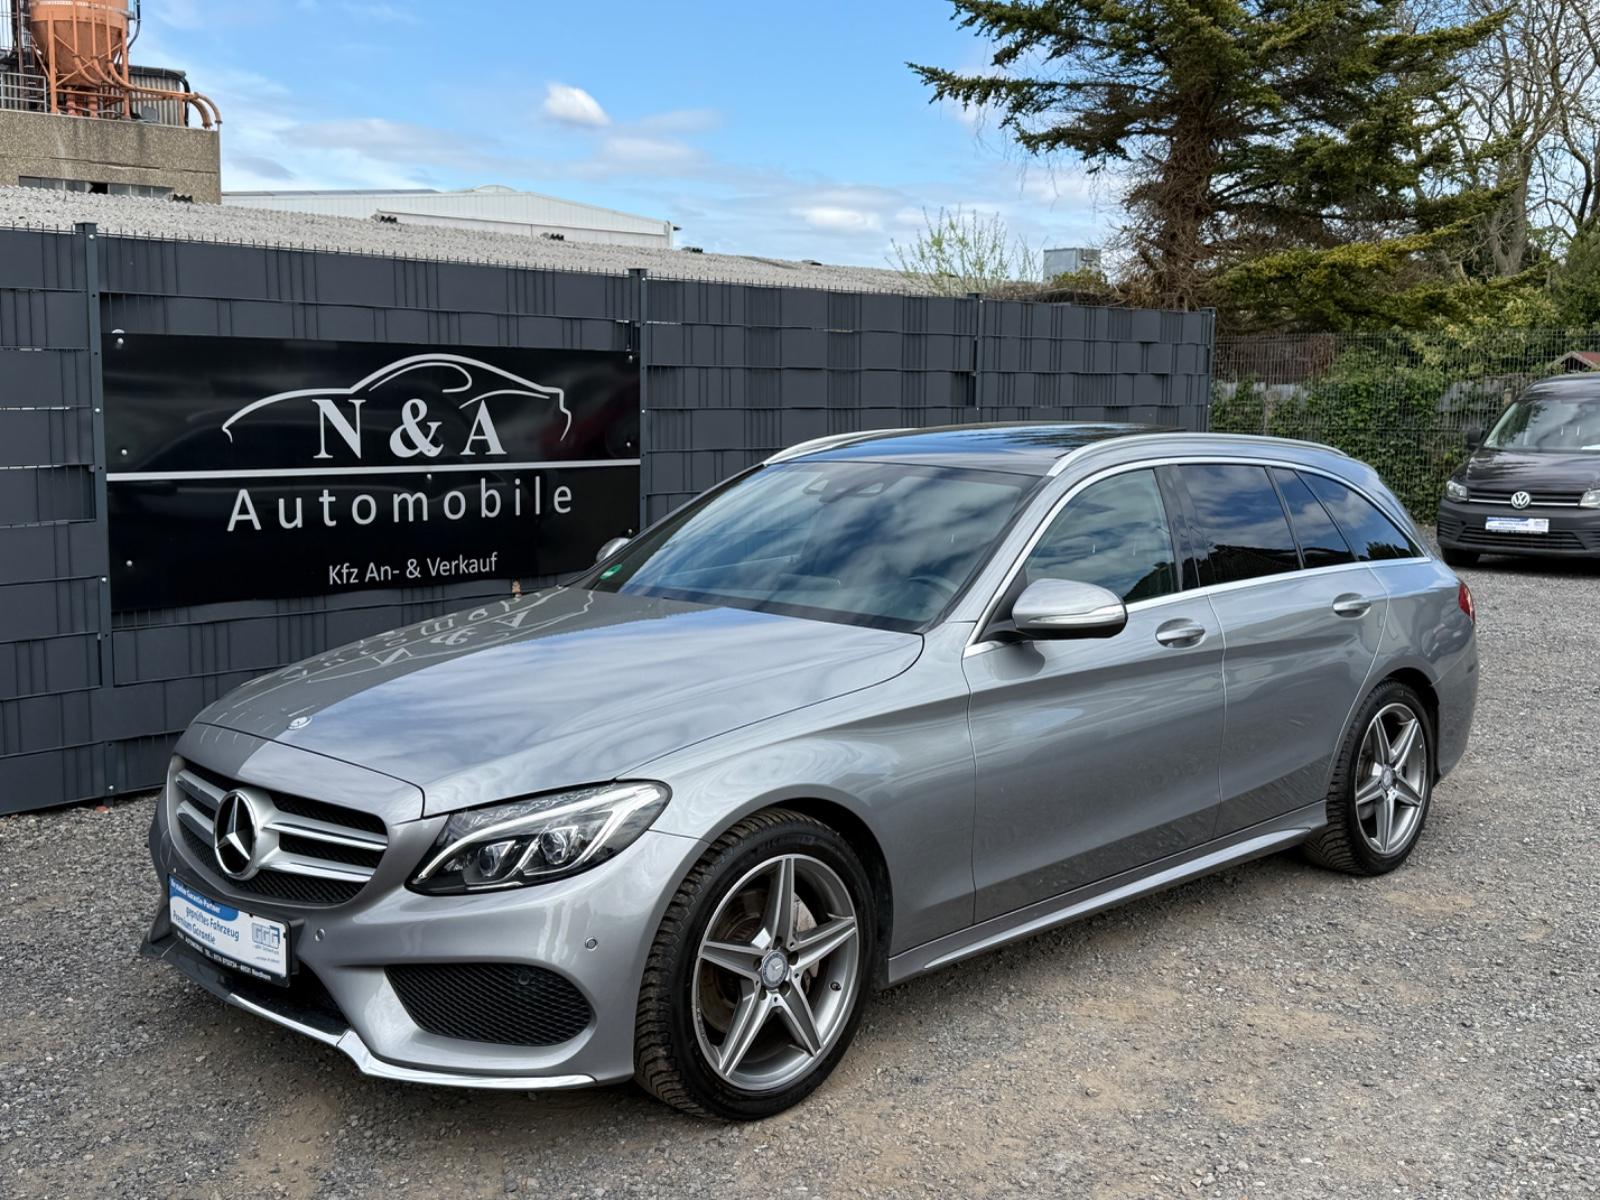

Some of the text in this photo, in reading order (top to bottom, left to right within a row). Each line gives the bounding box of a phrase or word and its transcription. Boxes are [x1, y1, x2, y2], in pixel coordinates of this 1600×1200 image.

[312, 398, 508, 460] N & A
[226, 475, 573, 533] Automobile
[328, 553, 498, 586] Kfz An- & Verkauf
[192, 923, 216, 944] Garantie
[210, 917, 240, 942] Fahrzeug
